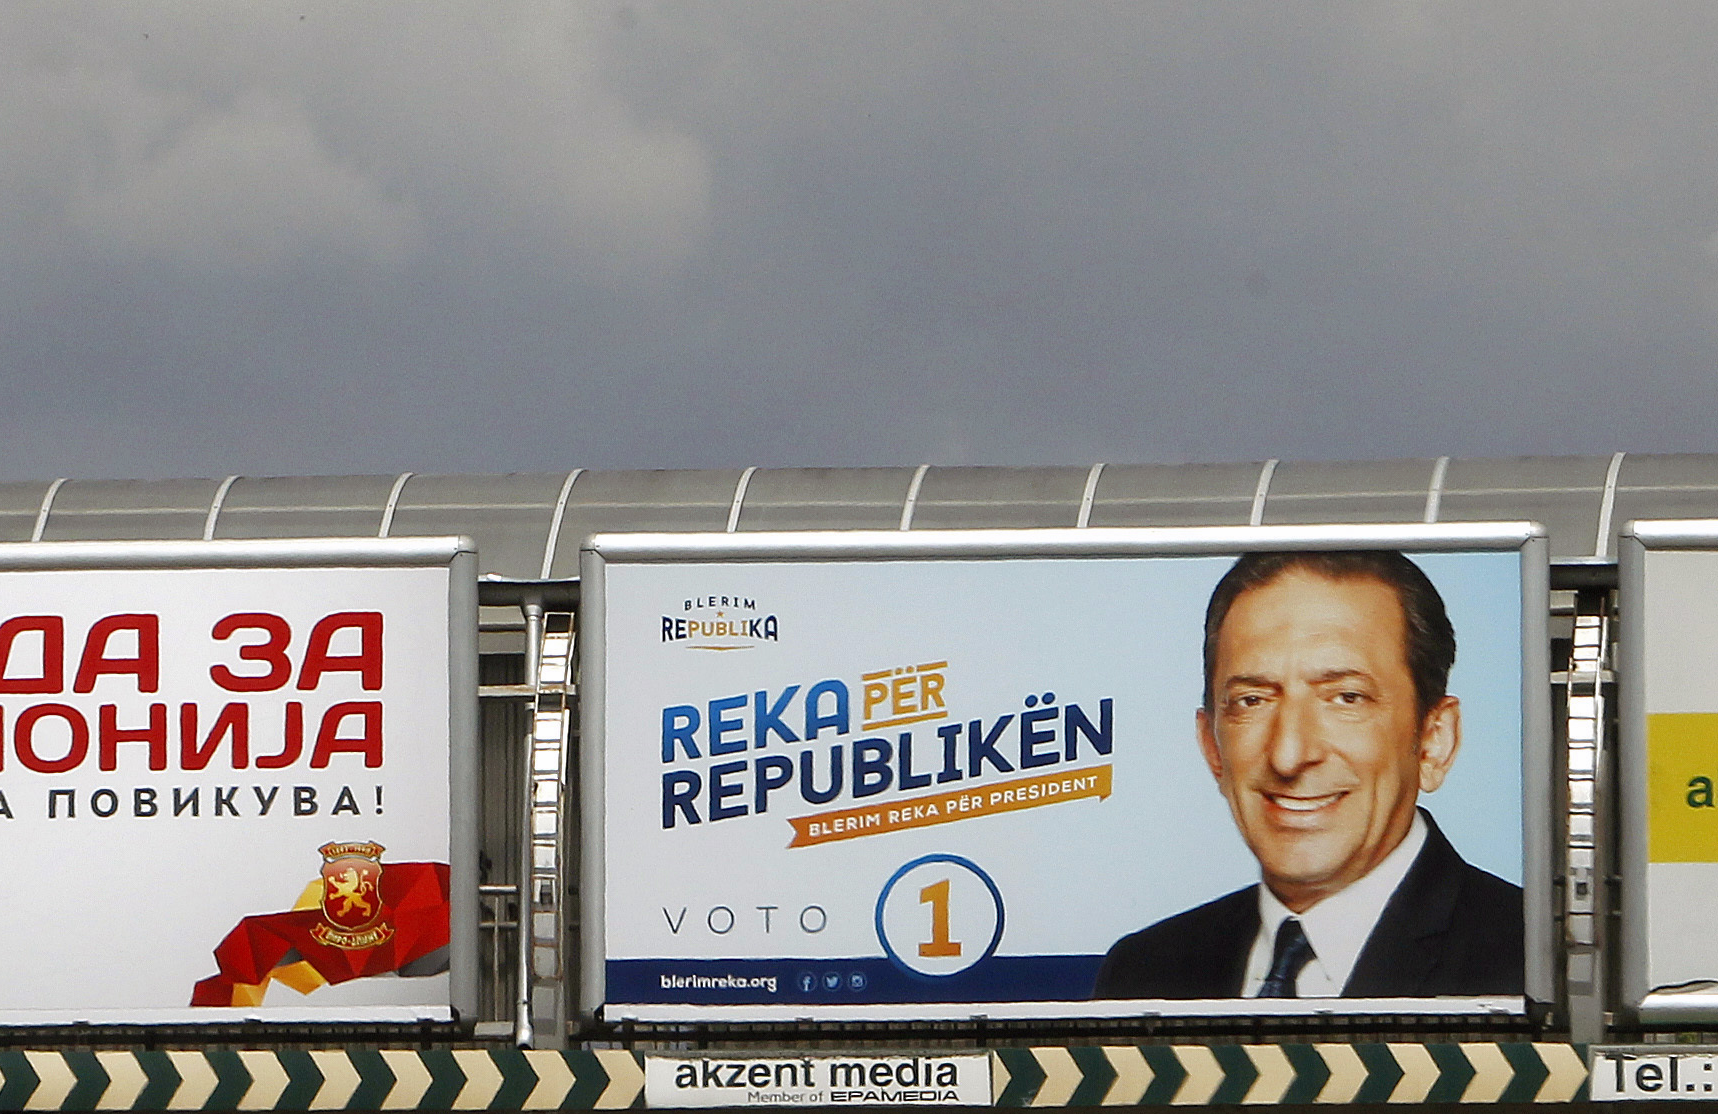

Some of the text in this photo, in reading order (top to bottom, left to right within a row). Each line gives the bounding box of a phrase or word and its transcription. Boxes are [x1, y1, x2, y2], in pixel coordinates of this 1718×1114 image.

[684, 596, 756, 611] BLERIM
[661, 615, 778, 642] REPUBLIKA
[209, 611, 384, 692] ЗА
[661, 664, 946, 763] REKA PËR
[662, 692, 1114, 829] REPUBLIKËN
[47, 784, 387, 820] ПОВИКУВА!
[808, 775, 1098, 838] BLERIM REKA PËR PRESIDENT
[662, 879, 963, 957] VOTO 1
[661, 974, 777, 992] blerimreka.org
[675, 1056, 958, 1088] akzent media
[1605, 1052, 1713, 1093] Tel.:
[747, 1090, 960, 1103] Member of EPAMEDIA
